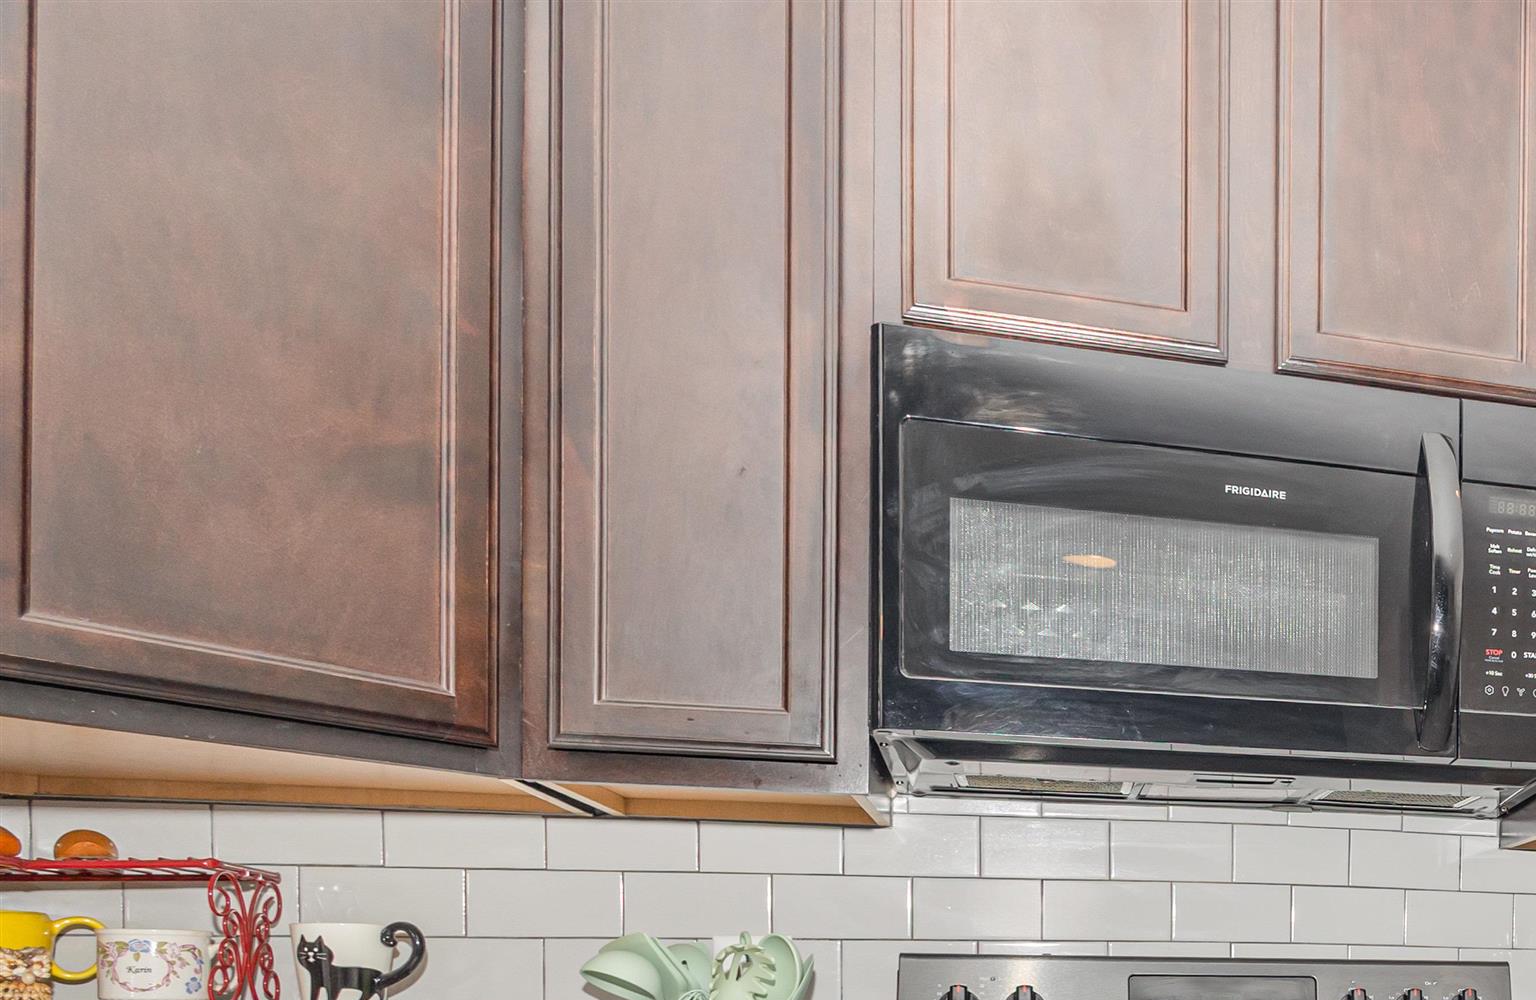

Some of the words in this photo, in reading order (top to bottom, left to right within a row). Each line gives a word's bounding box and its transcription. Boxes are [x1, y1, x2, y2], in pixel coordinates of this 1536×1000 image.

[1225, 484, 1287, 500] FRIGIDAIRE
[1491, 585, 1497, 594] 1
[1511, 587, 1518, 596] 2
[1531, 589, 1536, 597] 3
[1491, 606, 1498, 615] 4
[1511, 608, 1518, 616] 5
[1531, 610, 1536, 618] 6
[1491, 628, 1498, 636] 7
[1511, 630, 1517, 638] 8
[1530, 631, 1536, 639] 9
